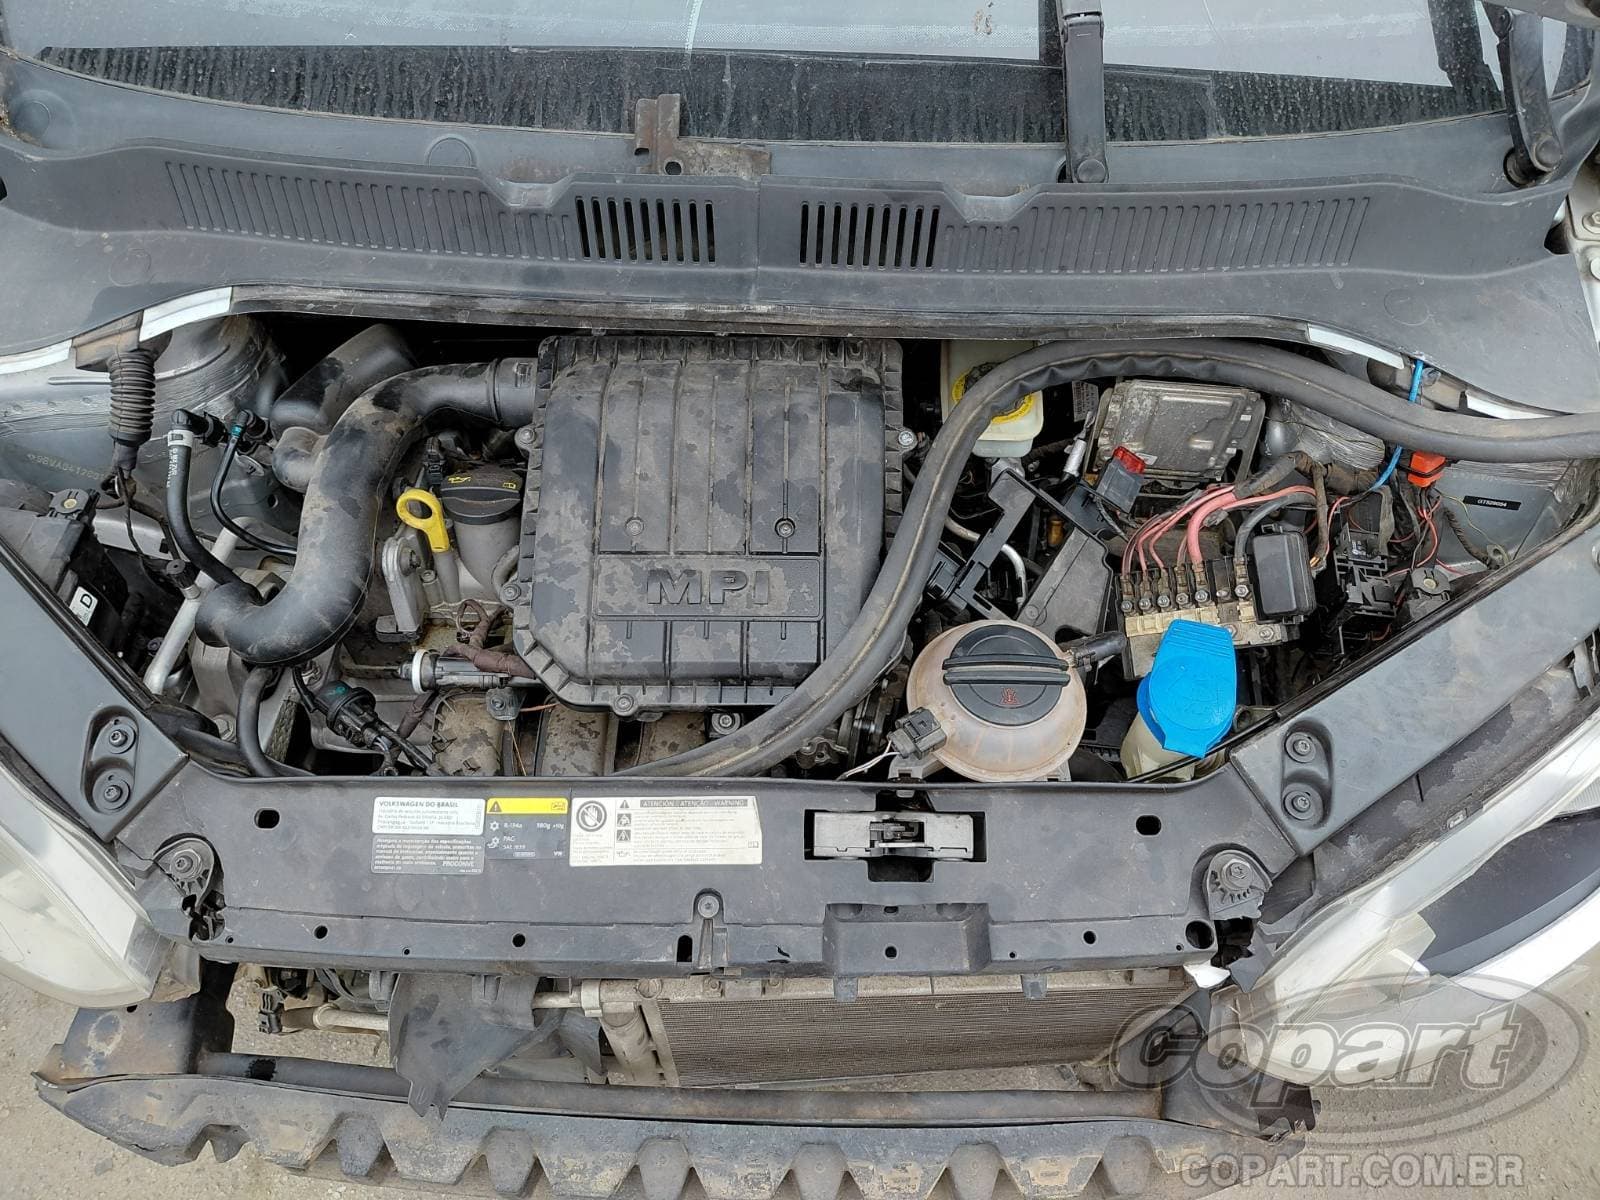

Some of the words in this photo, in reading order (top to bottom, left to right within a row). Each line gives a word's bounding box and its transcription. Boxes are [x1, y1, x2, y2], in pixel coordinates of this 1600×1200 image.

[646, 569, 769, 605] MPI
[80, 593, 93, 609] D
[714, 799, 745, 807] WARNING
